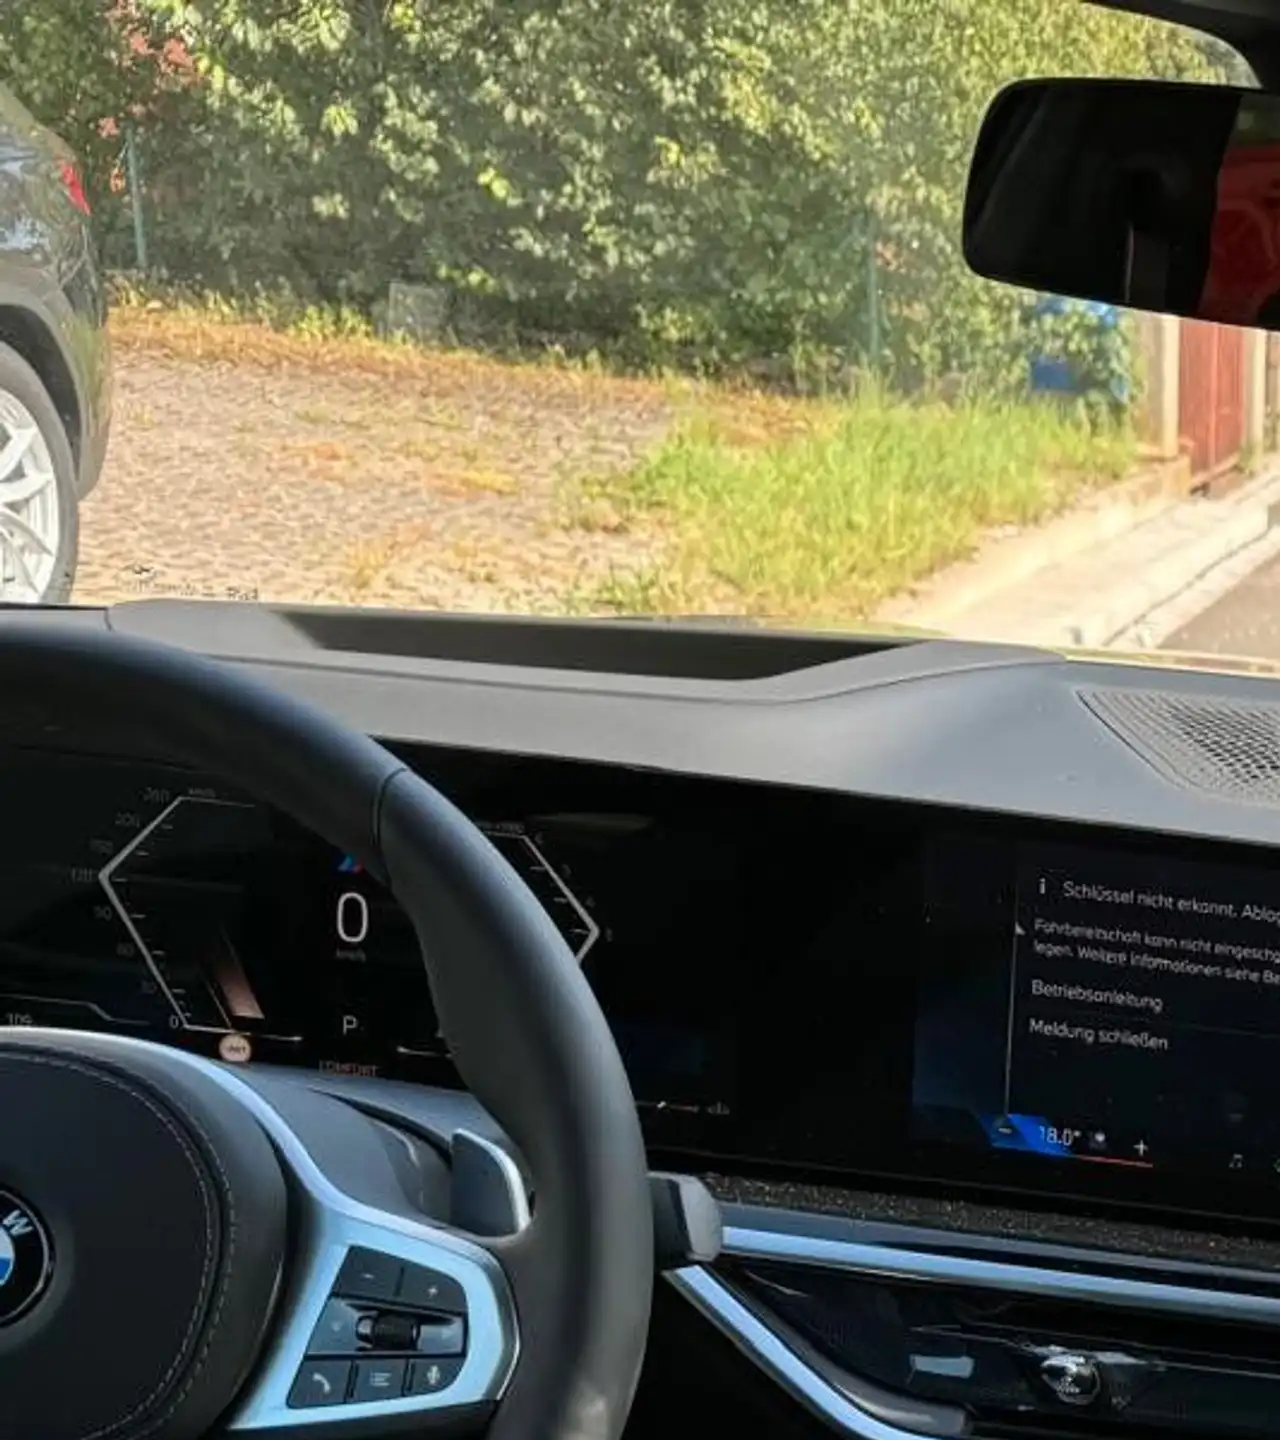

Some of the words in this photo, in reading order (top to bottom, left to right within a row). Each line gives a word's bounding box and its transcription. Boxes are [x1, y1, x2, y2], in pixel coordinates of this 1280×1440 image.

[336, 891, 369, 943] 0
[1063, 880, 1134, 905] Schlüssel
[1137, 891, 1174, 911] nicht
[1177, 897, 1237, 918] erkannt.
[1034, 917, 1142, 946] Fahrbereitschaft
[1144, 931, 1178, 949] kann
[1179, 935, 1212, 954] nicht
[1076, 945, 1127, 966] Weitere
[1129, 951, 1222, 978] Informationen
[1224, 964, 1261, 984] siehe
[1031, 978, 1164, 1014] Betriebsanleitung
[342, 1014, 359, 1036] P
[1028, 1017, 1096, 1044] Meldung
[1097, 1027, 1168, 1050] schließen
